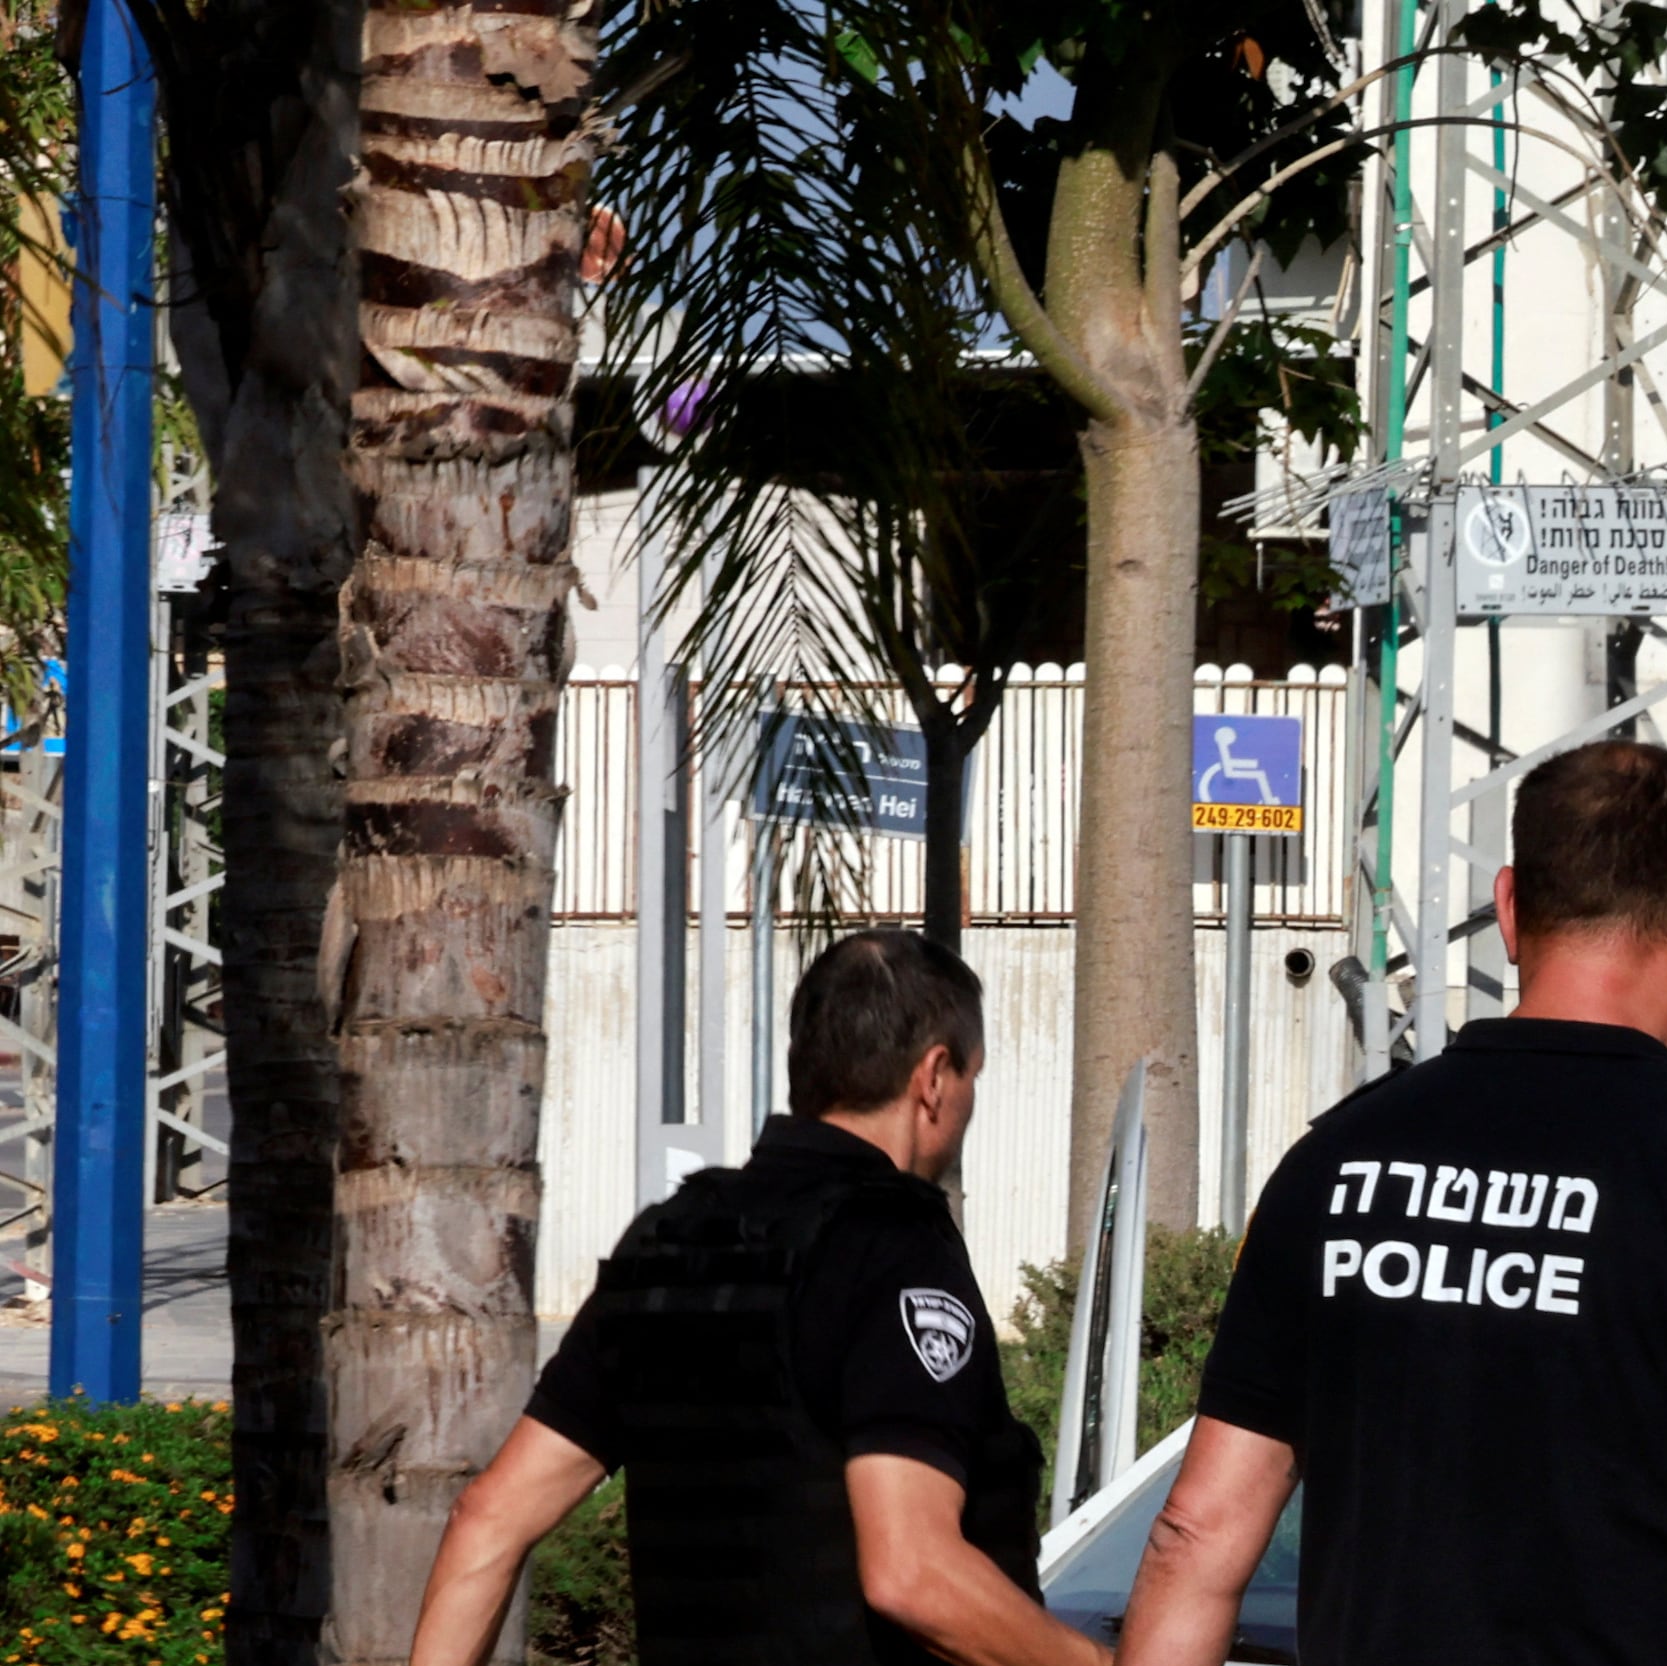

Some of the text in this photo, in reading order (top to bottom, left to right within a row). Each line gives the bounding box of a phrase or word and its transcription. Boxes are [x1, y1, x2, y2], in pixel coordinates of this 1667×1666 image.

[1541, 498, 1605, 520] גבוה!
[1609, 527, 1665, 548] סכנת
[1526, 554, 1587, 579] Danger
[1592, 554, 1611, 574] of
[1328, 1160, 1600, 1234] משטרה
[1322, 1239, 1585, 1316] POLICE
